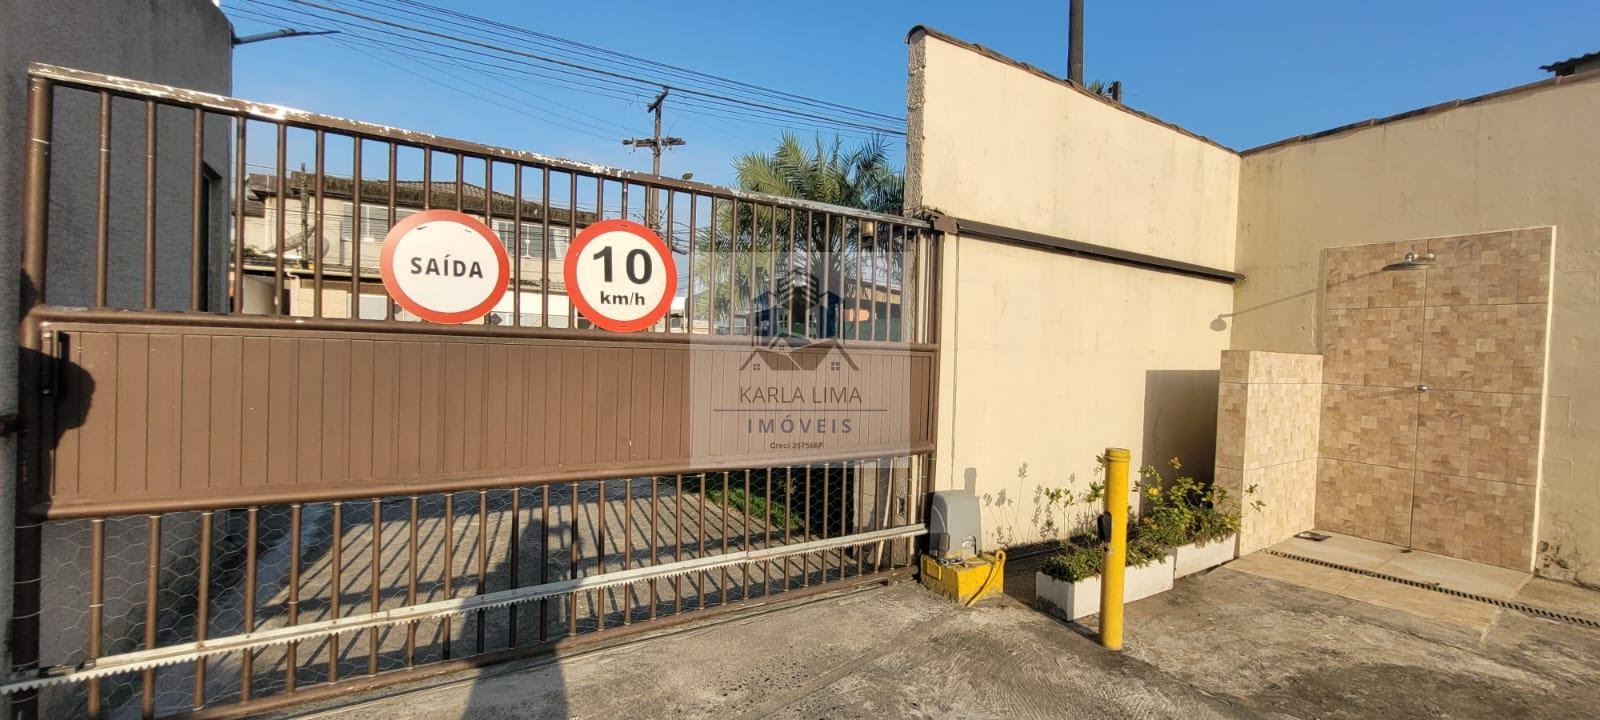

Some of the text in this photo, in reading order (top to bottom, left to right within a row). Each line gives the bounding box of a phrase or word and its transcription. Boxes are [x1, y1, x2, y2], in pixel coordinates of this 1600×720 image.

[410, 254, 484, 279] SAÍDA
[592, 245, 653, 285] 10
[599, 290, 646, 306] km/h
